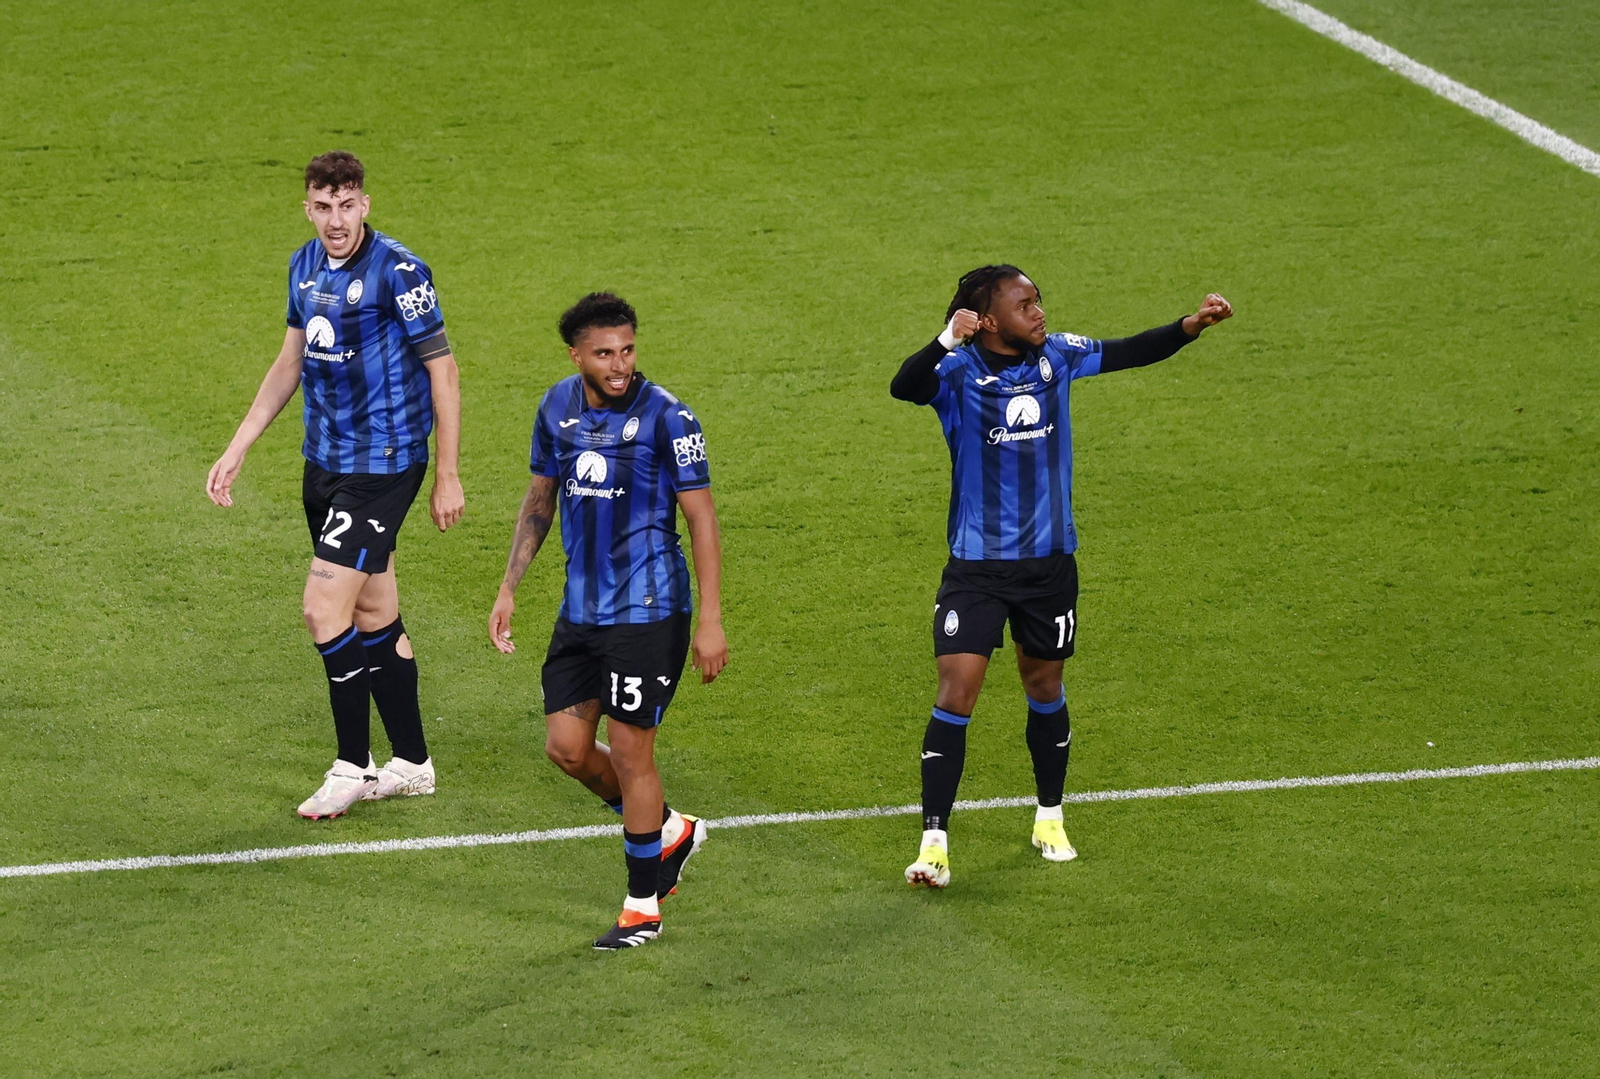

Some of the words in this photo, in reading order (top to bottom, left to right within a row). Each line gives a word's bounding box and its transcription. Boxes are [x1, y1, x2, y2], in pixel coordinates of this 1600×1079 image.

[986, 422, 1054, 445] Paramount+
[676, 446, 707, 467] GROU
[1054, 608, 1075, 649] 11
[610, 671, 643, 712] 13
